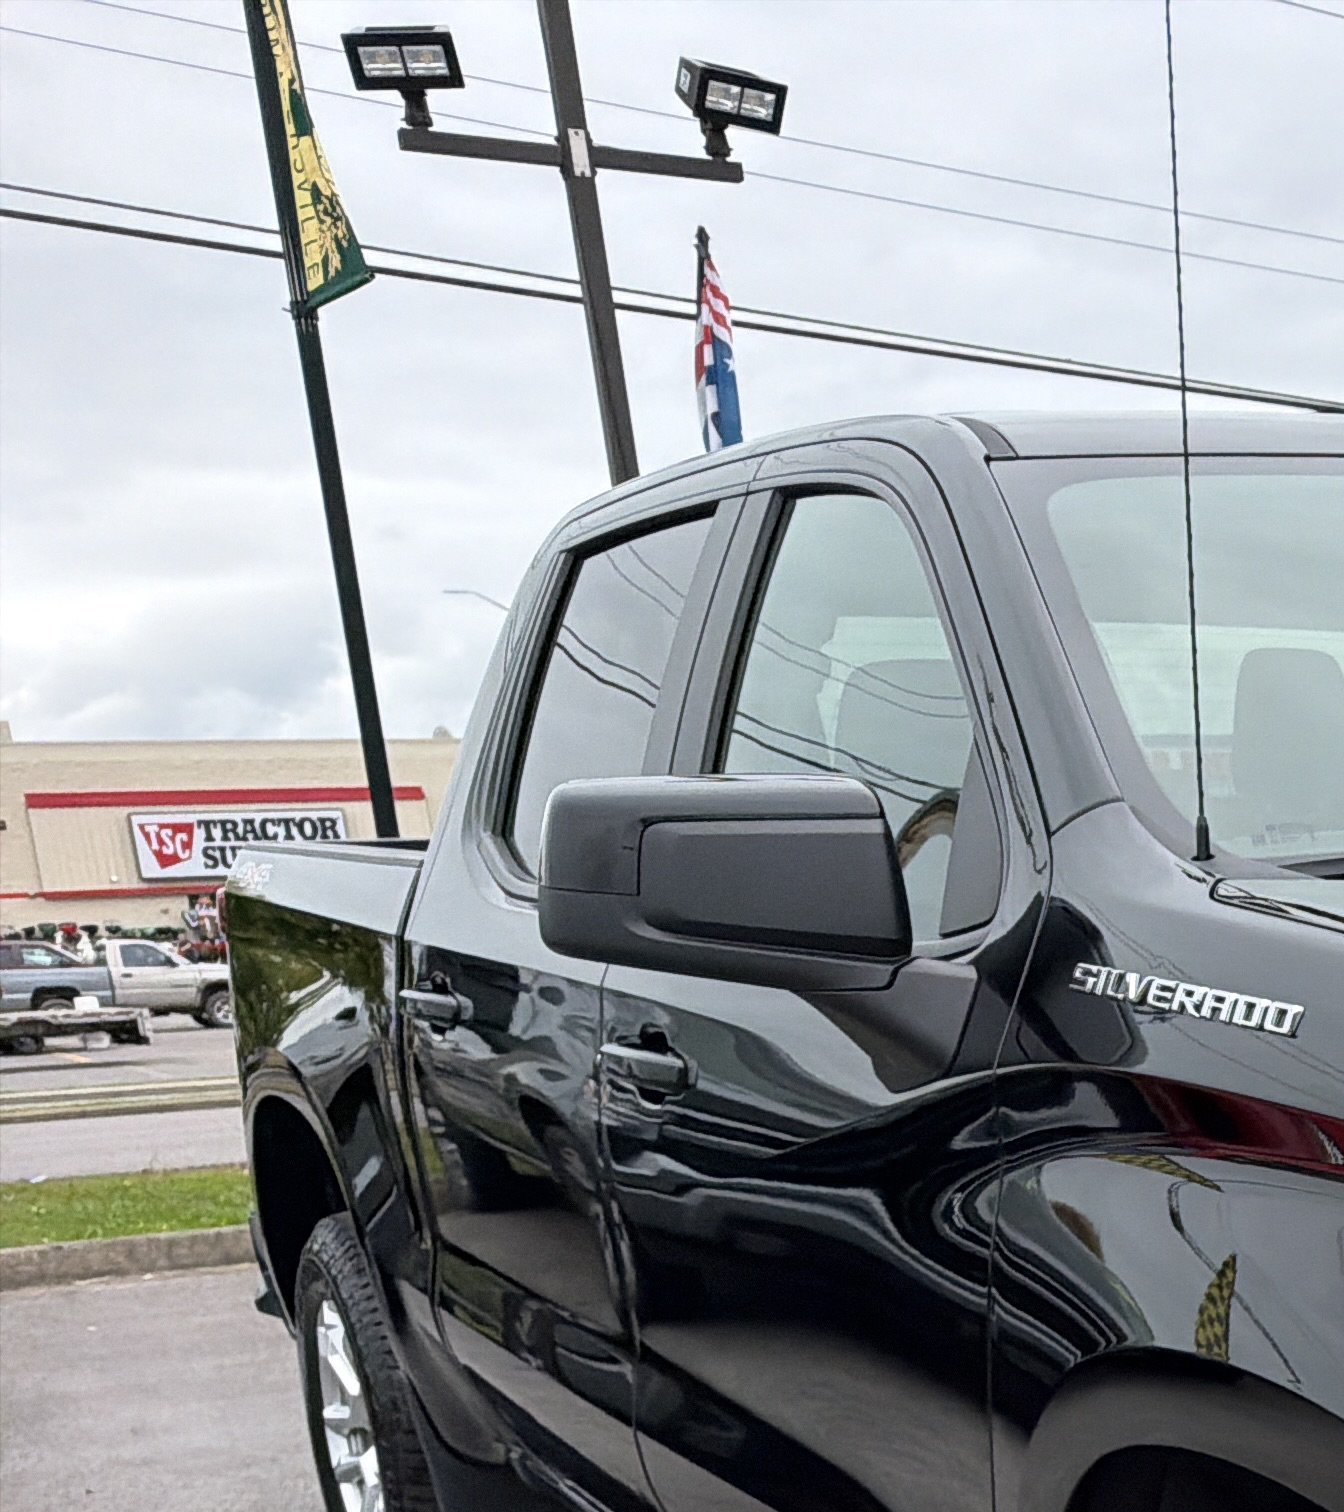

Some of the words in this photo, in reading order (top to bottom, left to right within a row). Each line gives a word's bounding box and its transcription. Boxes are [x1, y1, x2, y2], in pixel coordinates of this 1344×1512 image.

[143, 824, 191, 860] TSC
[196, 816, 341, 843] TRACTOR
[1068, 962, 1306, 1037] SILVERADO
